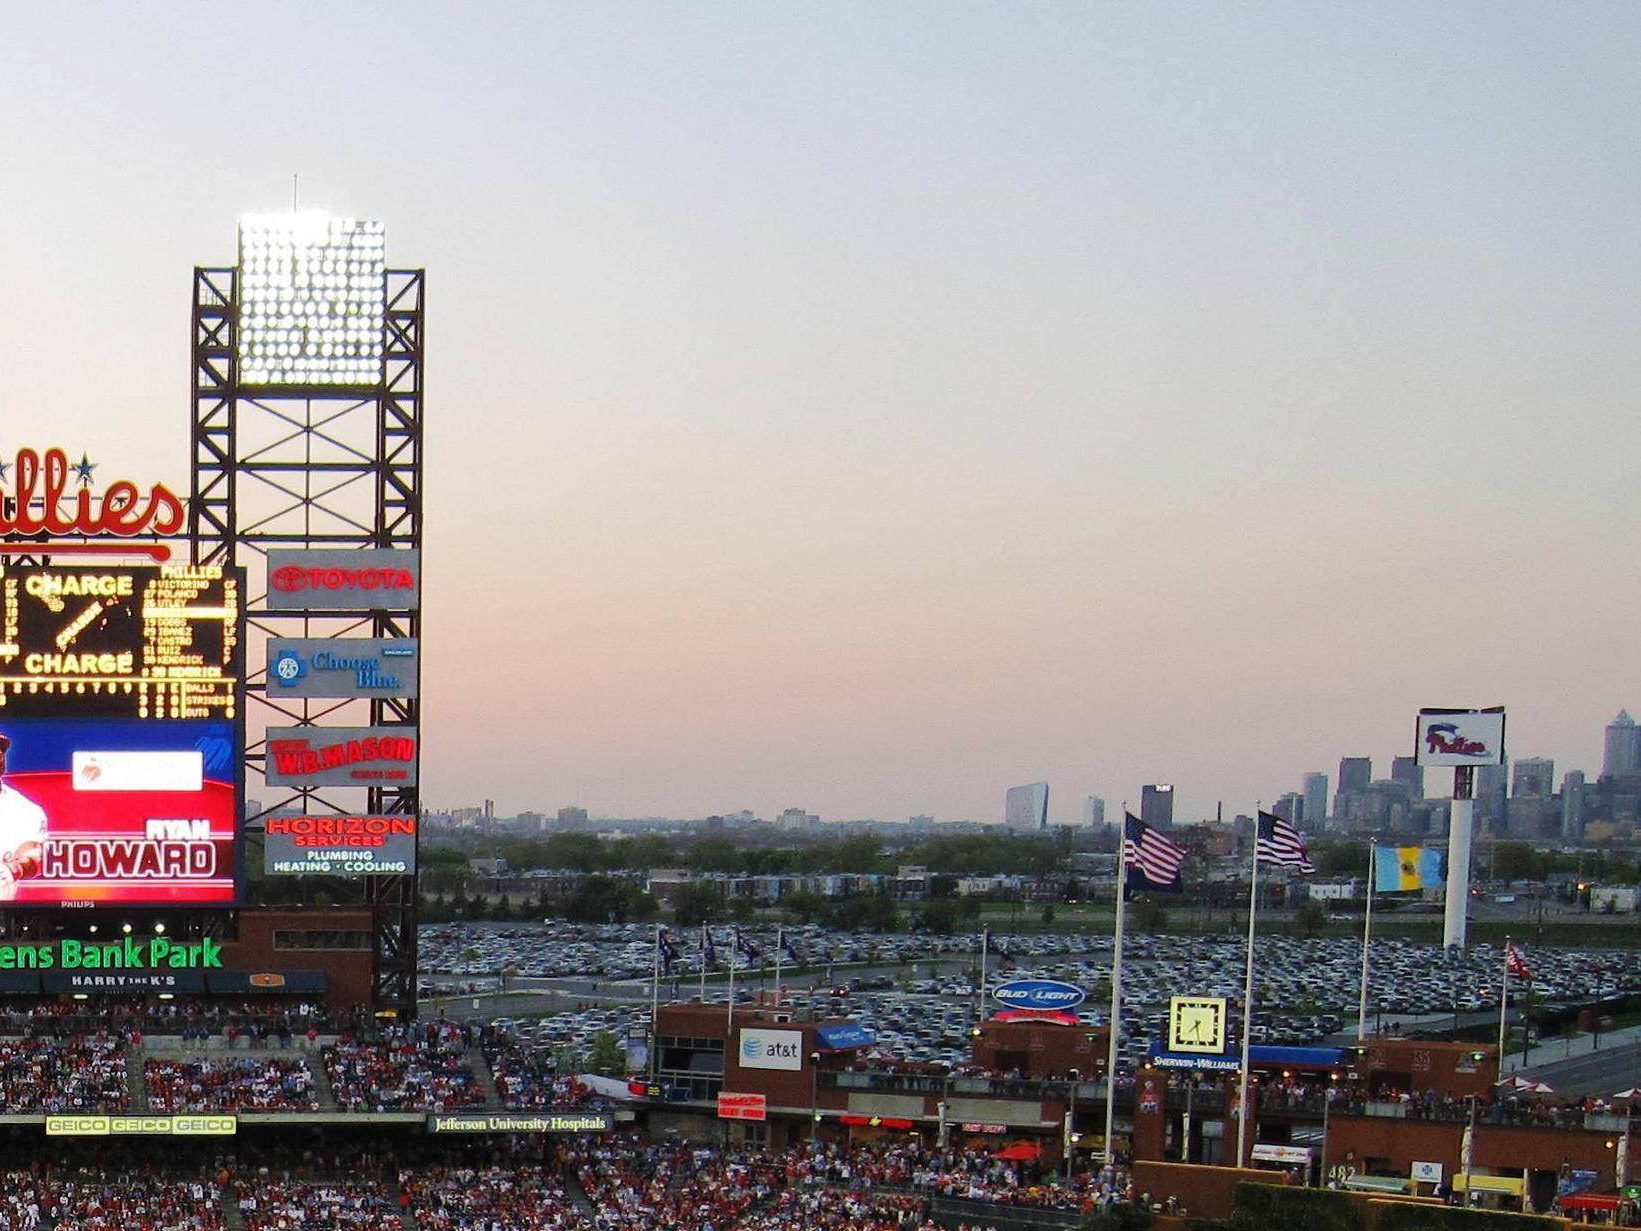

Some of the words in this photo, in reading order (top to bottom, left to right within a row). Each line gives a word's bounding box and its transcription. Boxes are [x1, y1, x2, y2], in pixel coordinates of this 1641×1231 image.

[161, 565, 222, 579] PHILLIES
[309, 567, 414, 591] TOYOTA
[25, 575, 133, 596] CHARGE
[25, 653, 133, 674] CHARGE
[312, 652, 380, 671] Choose
[146, 819, 210, 840] RYAN
[267, 817, 415, 835] HORIZON
[294, 836, 384, 847] SERVICES
[42, 840, 216, 877] HOWARD
[307, 850, 373, 861] PLUMBING
[274, 862, 331, 872] HEATING
[344, 862, 406, 872] COOLING
[61, 901, 95, 909] PHILIPS
[61, 937, 144, 969] Bank
[150, 937, 223, 969] Park
[72, 976, 126, 986] HARRY
[150, 975, 176, 986] K'S
[995, 989, 1029, 999] BUD
[1035, 990, 1080, 1001] LIGHT
[766, 1042, 798, 1058] at&t
[1153, 1055, 1240, 1070] SHERWIN-WILLIAMS
[48, 1119, 106, 1132] GEICO
[111, 1119, 171, 1132] GEICO
[176, 1119, 234, 1131] GEICO
[435, 1117, 486, 1133] Jefferson
[489, 1117, 549, 1133] University
[551, 1116, 606, 1132] Hospitals
